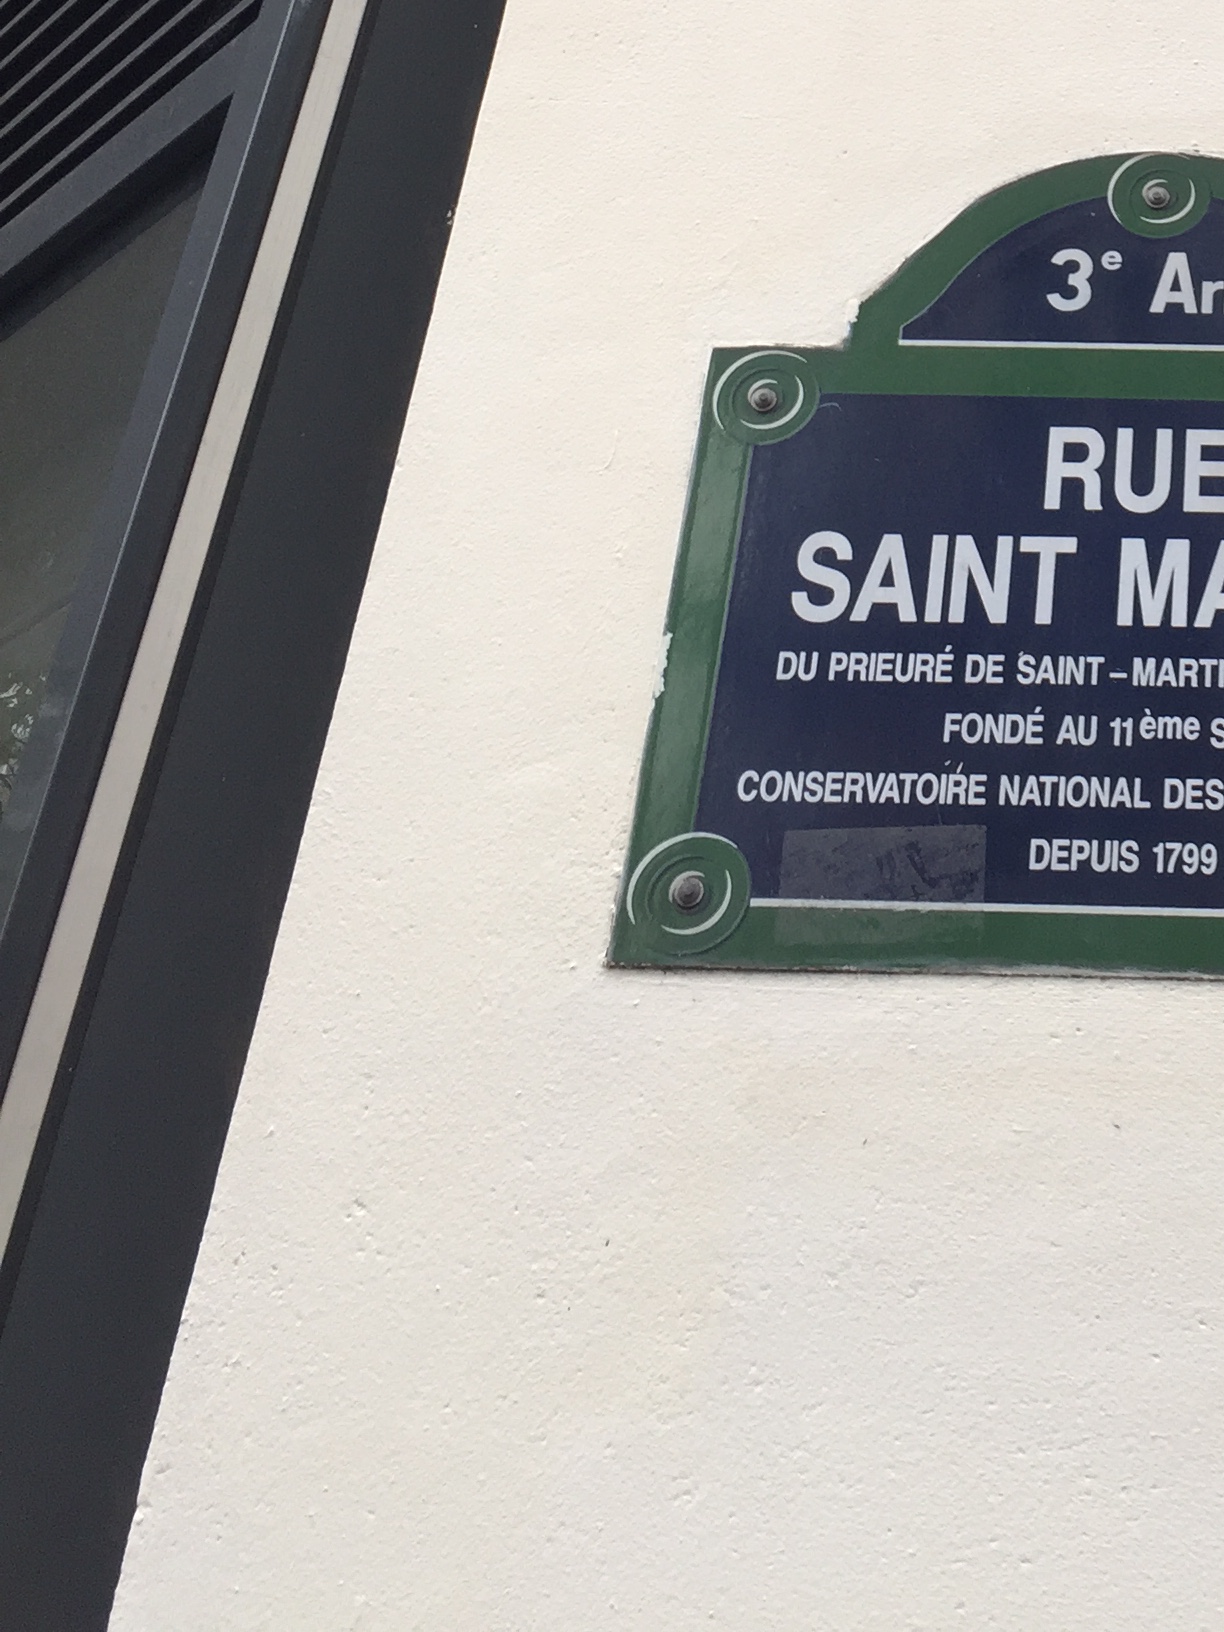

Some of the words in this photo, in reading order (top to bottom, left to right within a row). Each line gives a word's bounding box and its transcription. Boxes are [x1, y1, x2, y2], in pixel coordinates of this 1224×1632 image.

[791, 530, 1078, 625] SAINT
[776, 651, 819, 681] DU
[828, 644, 955, 684] PRIEURÉ
[964, 654, 1005, 684] DE
[943, 706, 1045, 745] FONDÉ
[1055, 715, 1098, 746] AU
[737, 770, 988, 806] CONSERVATOIRE
[998, 774, 1151, 809] NATIONAL
[1163, 778, 1224, 811] DES
[1028, 838, 1140, 873] DEPUIS
[1152, 842, 1218, 875] 1799
